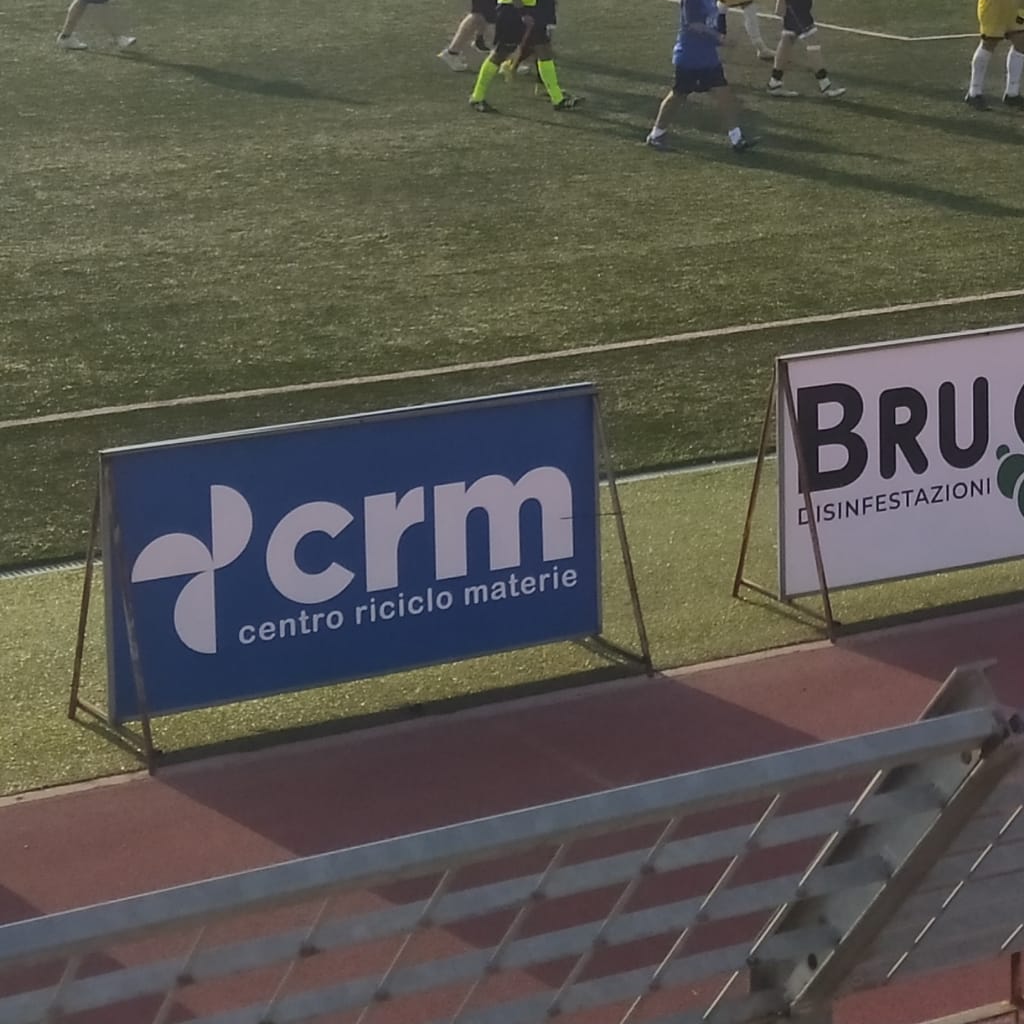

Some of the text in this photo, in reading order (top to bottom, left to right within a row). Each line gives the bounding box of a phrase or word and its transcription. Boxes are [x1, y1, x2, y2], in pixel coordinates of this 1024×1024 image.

[265, 465, 575, 605] crm
[798, 477, 991, 526] DISINFESTAZIONI
[238, 566, 578, 645] centro riciclo materie
